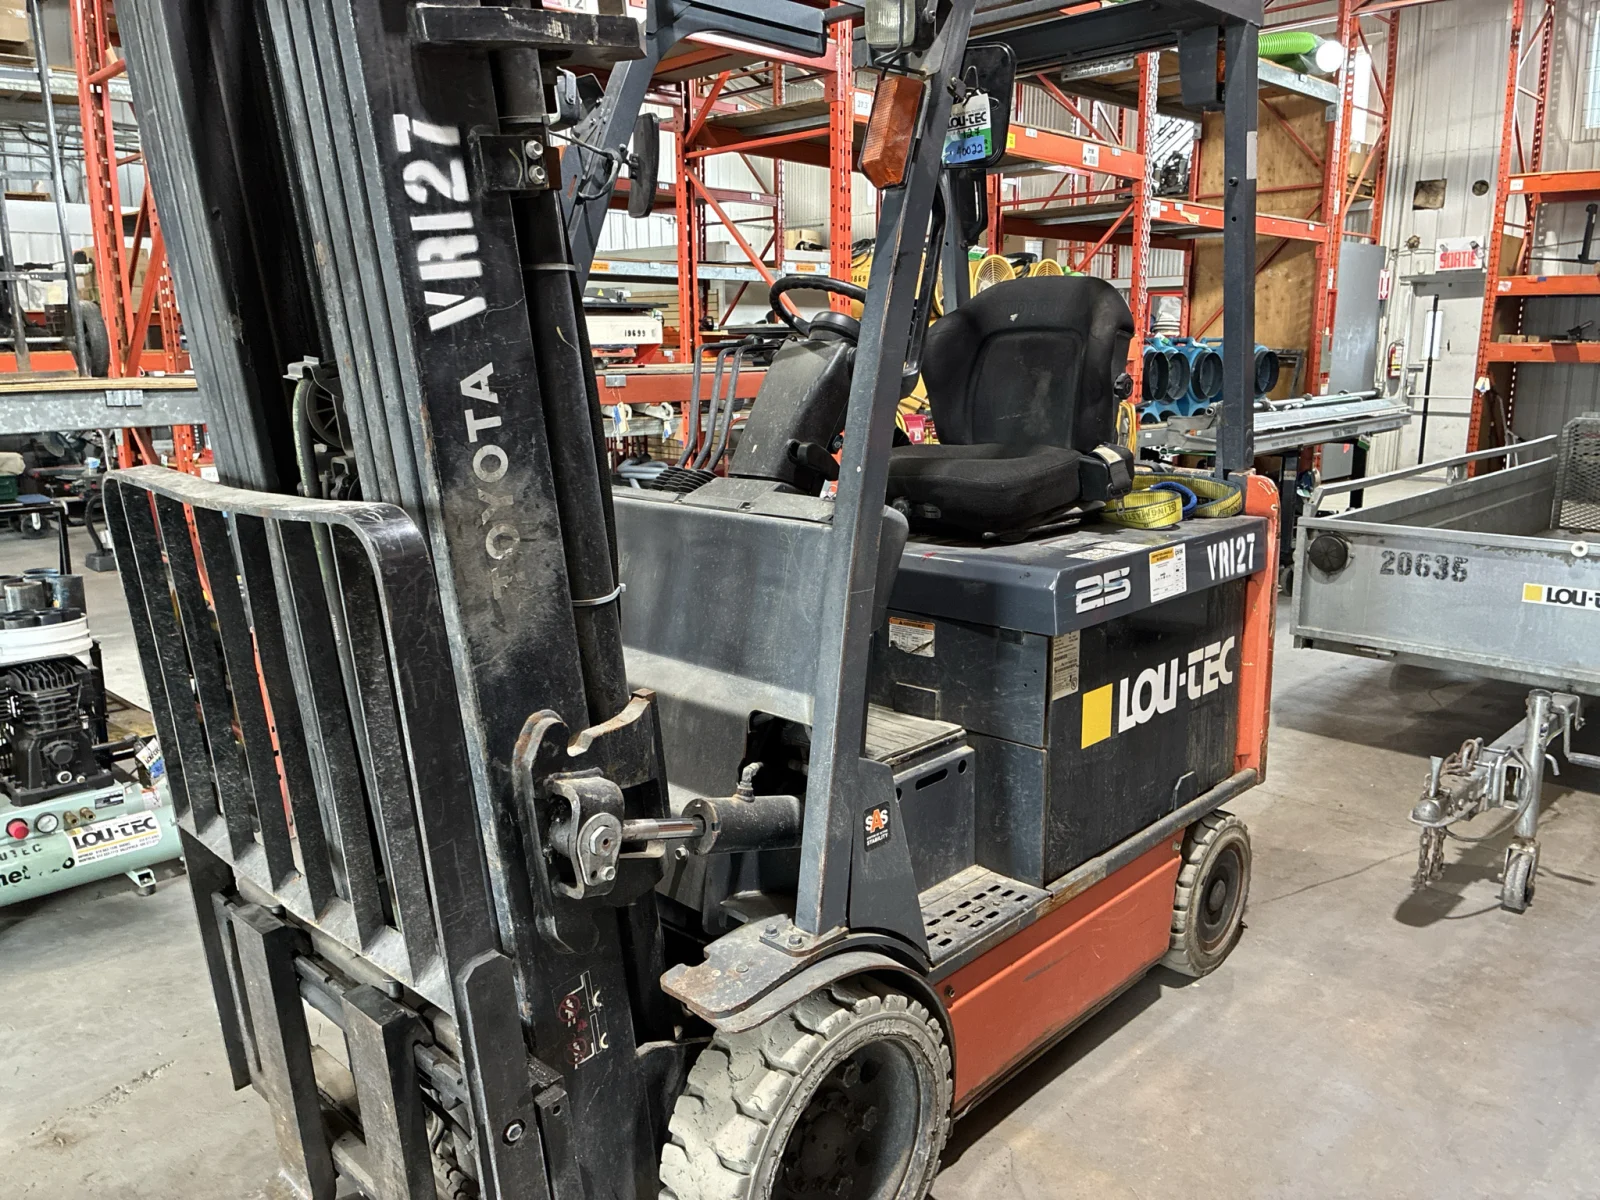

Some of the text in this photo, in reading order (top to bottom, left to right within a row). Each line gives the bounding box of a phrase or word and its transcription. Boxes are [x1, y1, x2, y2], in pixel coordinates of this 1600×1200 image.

[1440, 250, 1477, 269] SORTIE
[1075, 566, 1131, 614] 25
[1118, 635, 1235, 734] LOU-TEC
[72, 816, 157, 850] LOU-TEC
[865, 809, 888, 833] SAS
